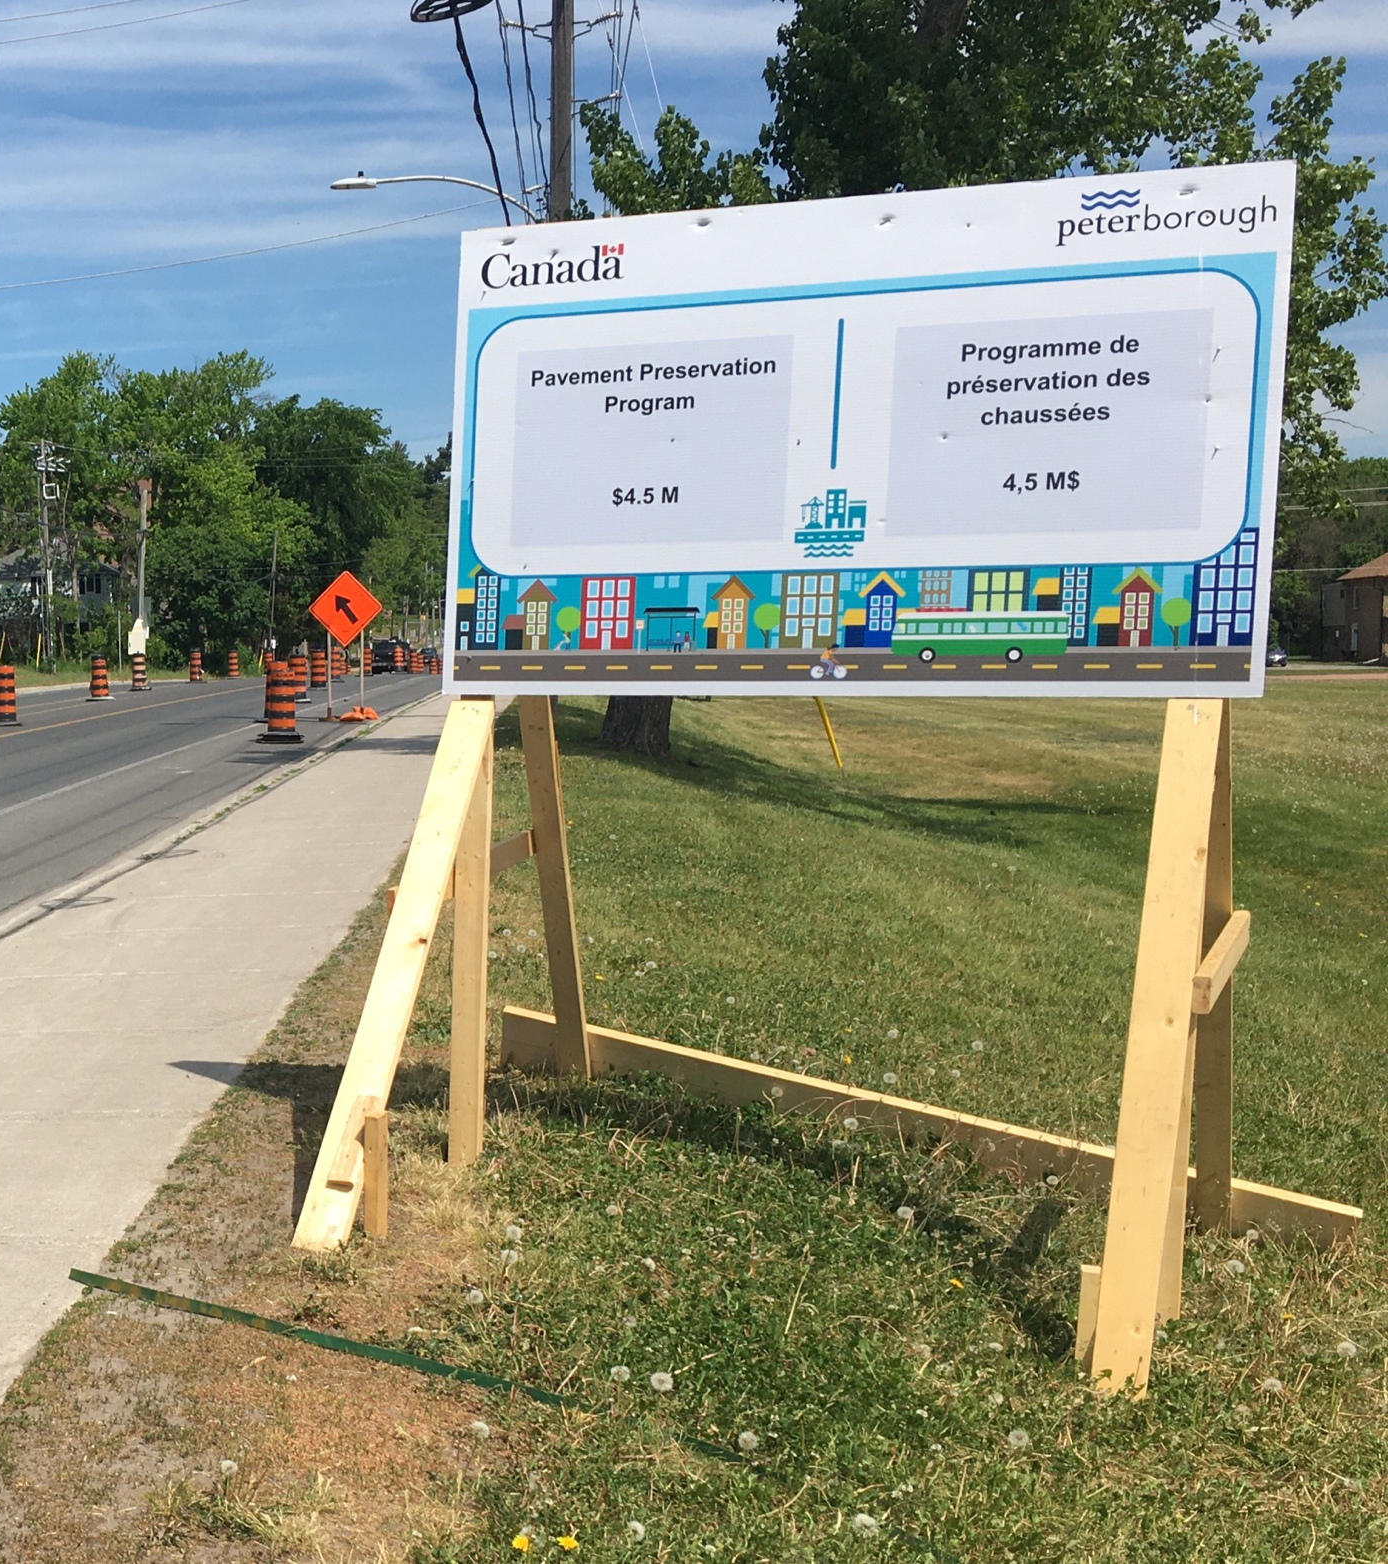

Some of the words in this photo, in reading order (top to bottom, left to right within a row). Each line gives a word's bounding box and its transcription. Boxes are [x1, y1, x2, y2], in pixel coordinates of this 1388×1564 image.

[1055, 195, 1277, 247] peterborough
[481, 245, 624, 289] Canada
[961, 340, 1101, 364] Programme
[1110, 335, 1140, 354] de
[531, 365, 633, 387] Pavement
[640, 358, 777, 381] Preservation
[947, 371, 1098, 399] préservation
[1106, 368, 1151, 387] des
[605, 395, 695, 416] Program
[980, 403, 1110, 425] chaussées
[612, 487, 655, 507] $4.5
[661, 486, 680, 504] M
[1003, 472, 1038, 494] 4,5
[1046, 470, 1080, 491] M$
